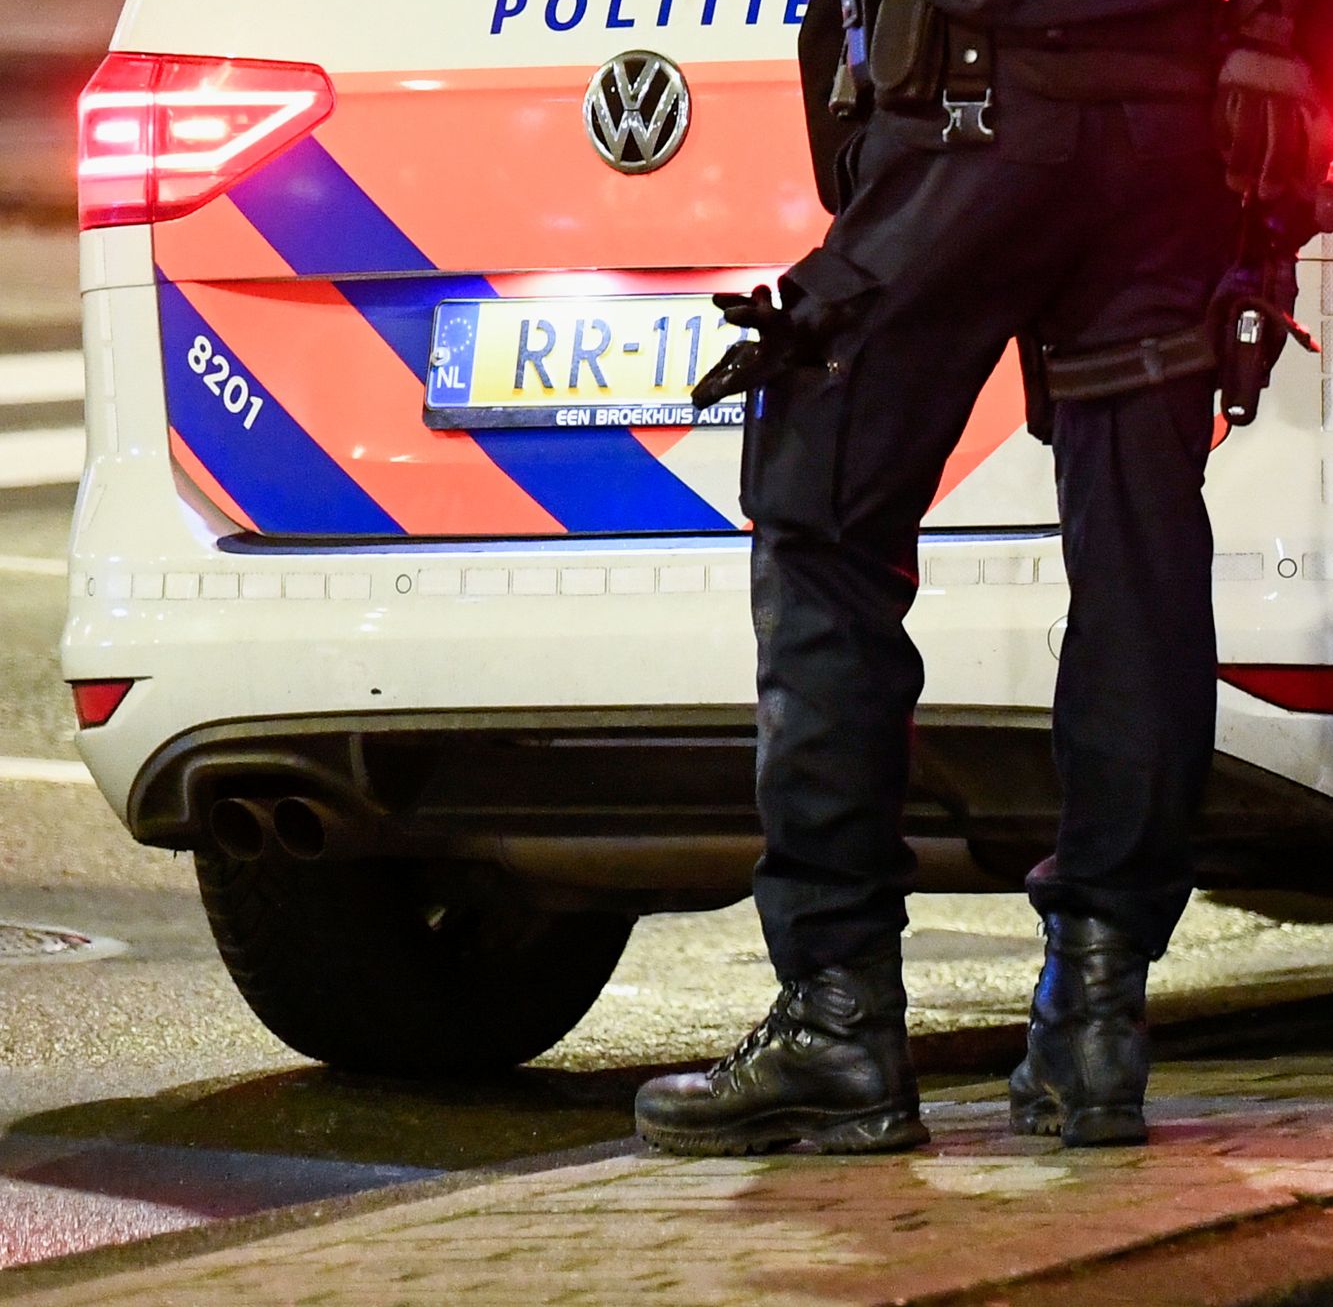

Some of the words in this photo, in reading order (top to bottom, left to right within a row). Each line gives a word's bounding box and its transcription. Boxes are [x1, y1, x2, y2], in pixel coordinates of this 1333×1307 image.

[187, 335, 264, 430] 8201
[436, 366, 466, 389] NL
[555, 409, 590, 426] EEN
[595, 408, 693, 425] BROEKHUIS
[697, 407, 745, 424] AUTO
